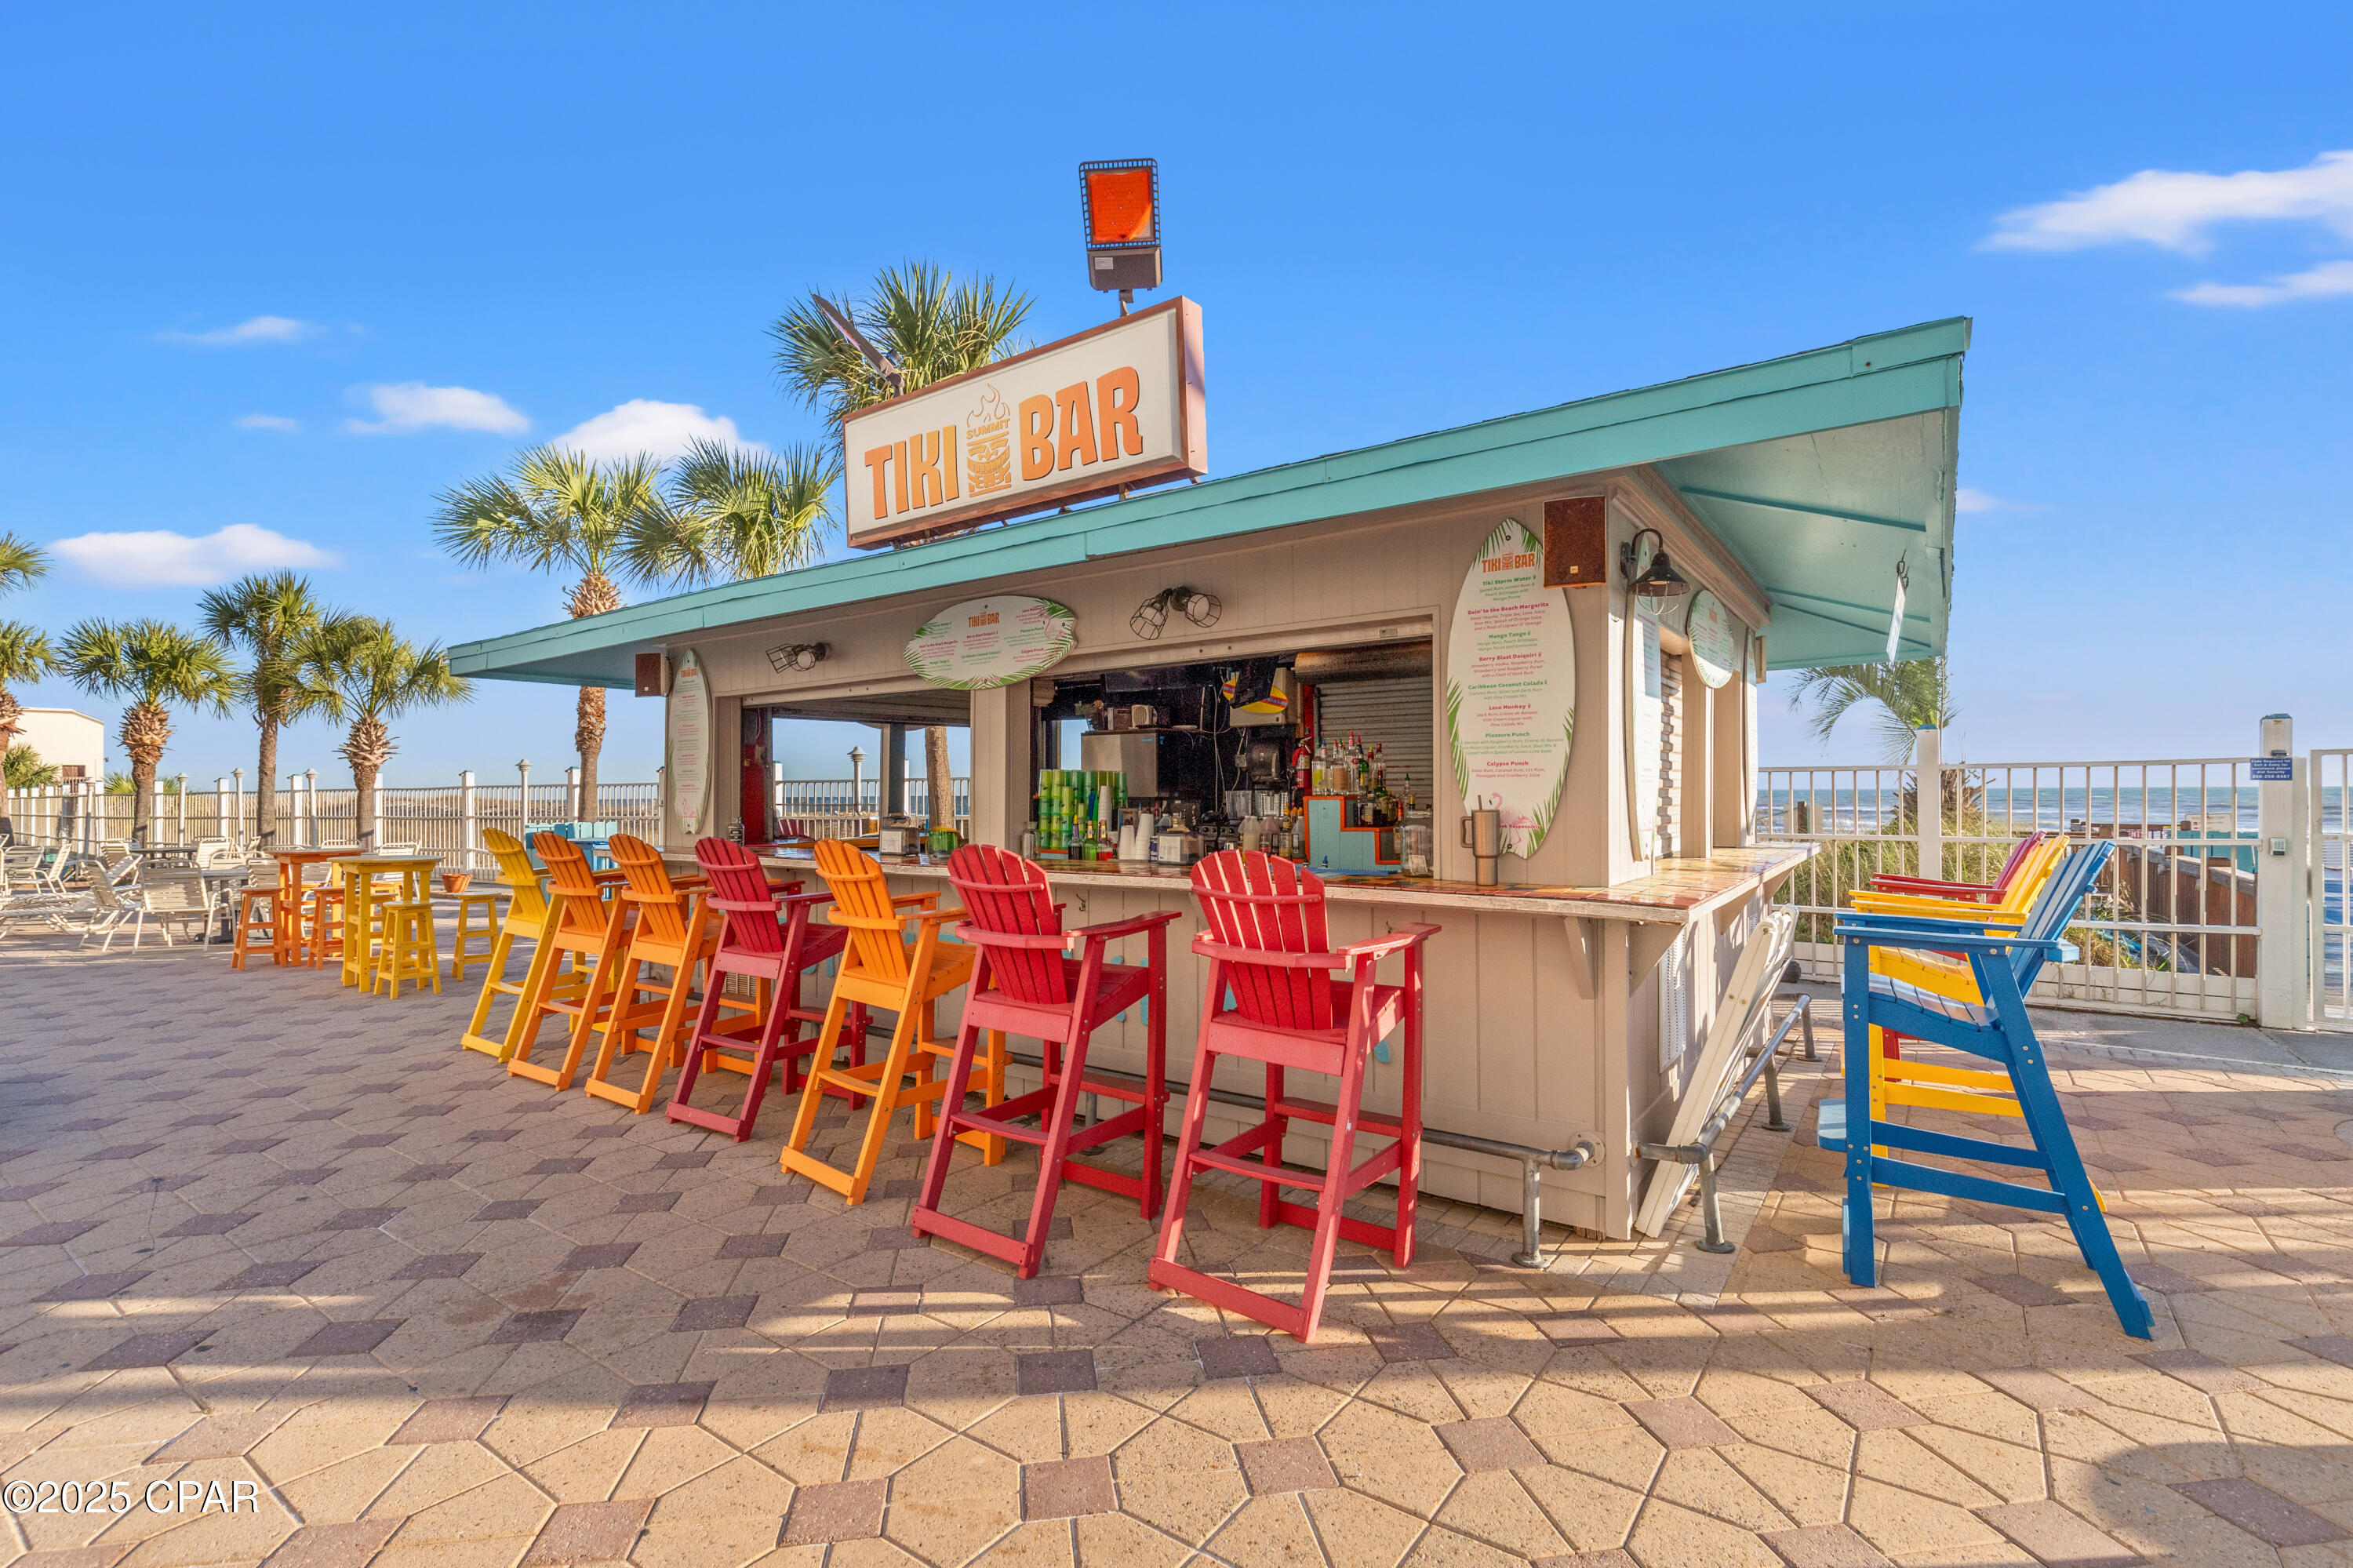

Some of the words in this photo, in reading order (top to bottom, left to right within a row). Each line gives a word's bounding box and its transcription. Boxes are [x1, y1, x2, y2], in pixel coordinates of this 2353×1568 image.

[966, 418, 1010, 439] SUMMIT
[865, 425, 959, 518] TIKI
[1019, 366, 1143, 481] BAR
[1482, 558, 1500, 573] TIKI
[1515, 553, 1535, 569] BAR
[968, 616, 980, 628] TIKI
[987, 612, 999, 624] BAR
